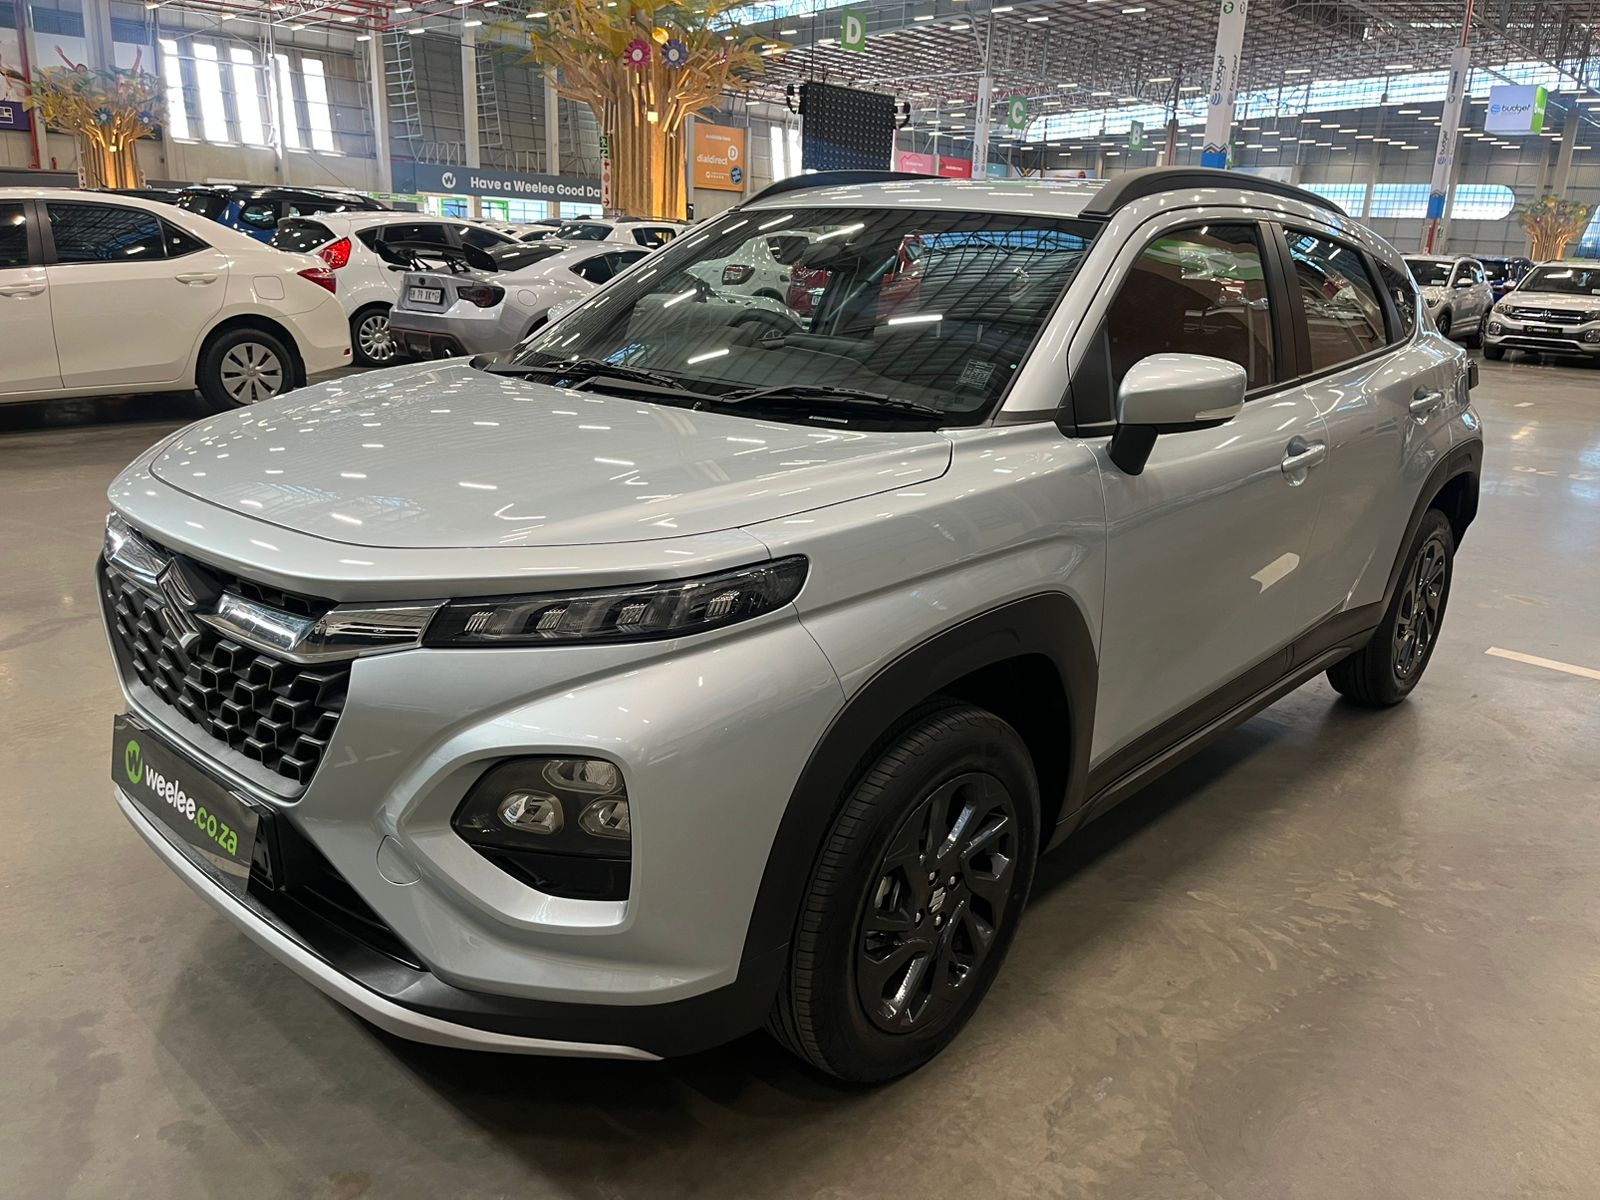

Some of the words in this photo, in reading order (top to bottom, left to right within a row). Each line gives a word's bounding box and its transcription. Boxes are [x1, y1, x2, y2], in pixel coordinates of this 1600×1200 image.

[846, 16, 862, 44] D
[1213, 54, 1226, 91] budget
[1011, 101, 1024, 124] C
[1501, 103, 1531, 115] budget
[1132, 125, 1141, 145] B
[1439, 130, 1449, 155] budget
[696, 153, 729, 166] dialdirect
[470, 176, 501, 190] Have
[503, 182, 511, 191] a
[513, 179, 555, 194] Weelee
[556, 184, 585, 197] Good
[586, 186, 601, 198] Da
[145, 764, 238, 857] weelee.co.za
